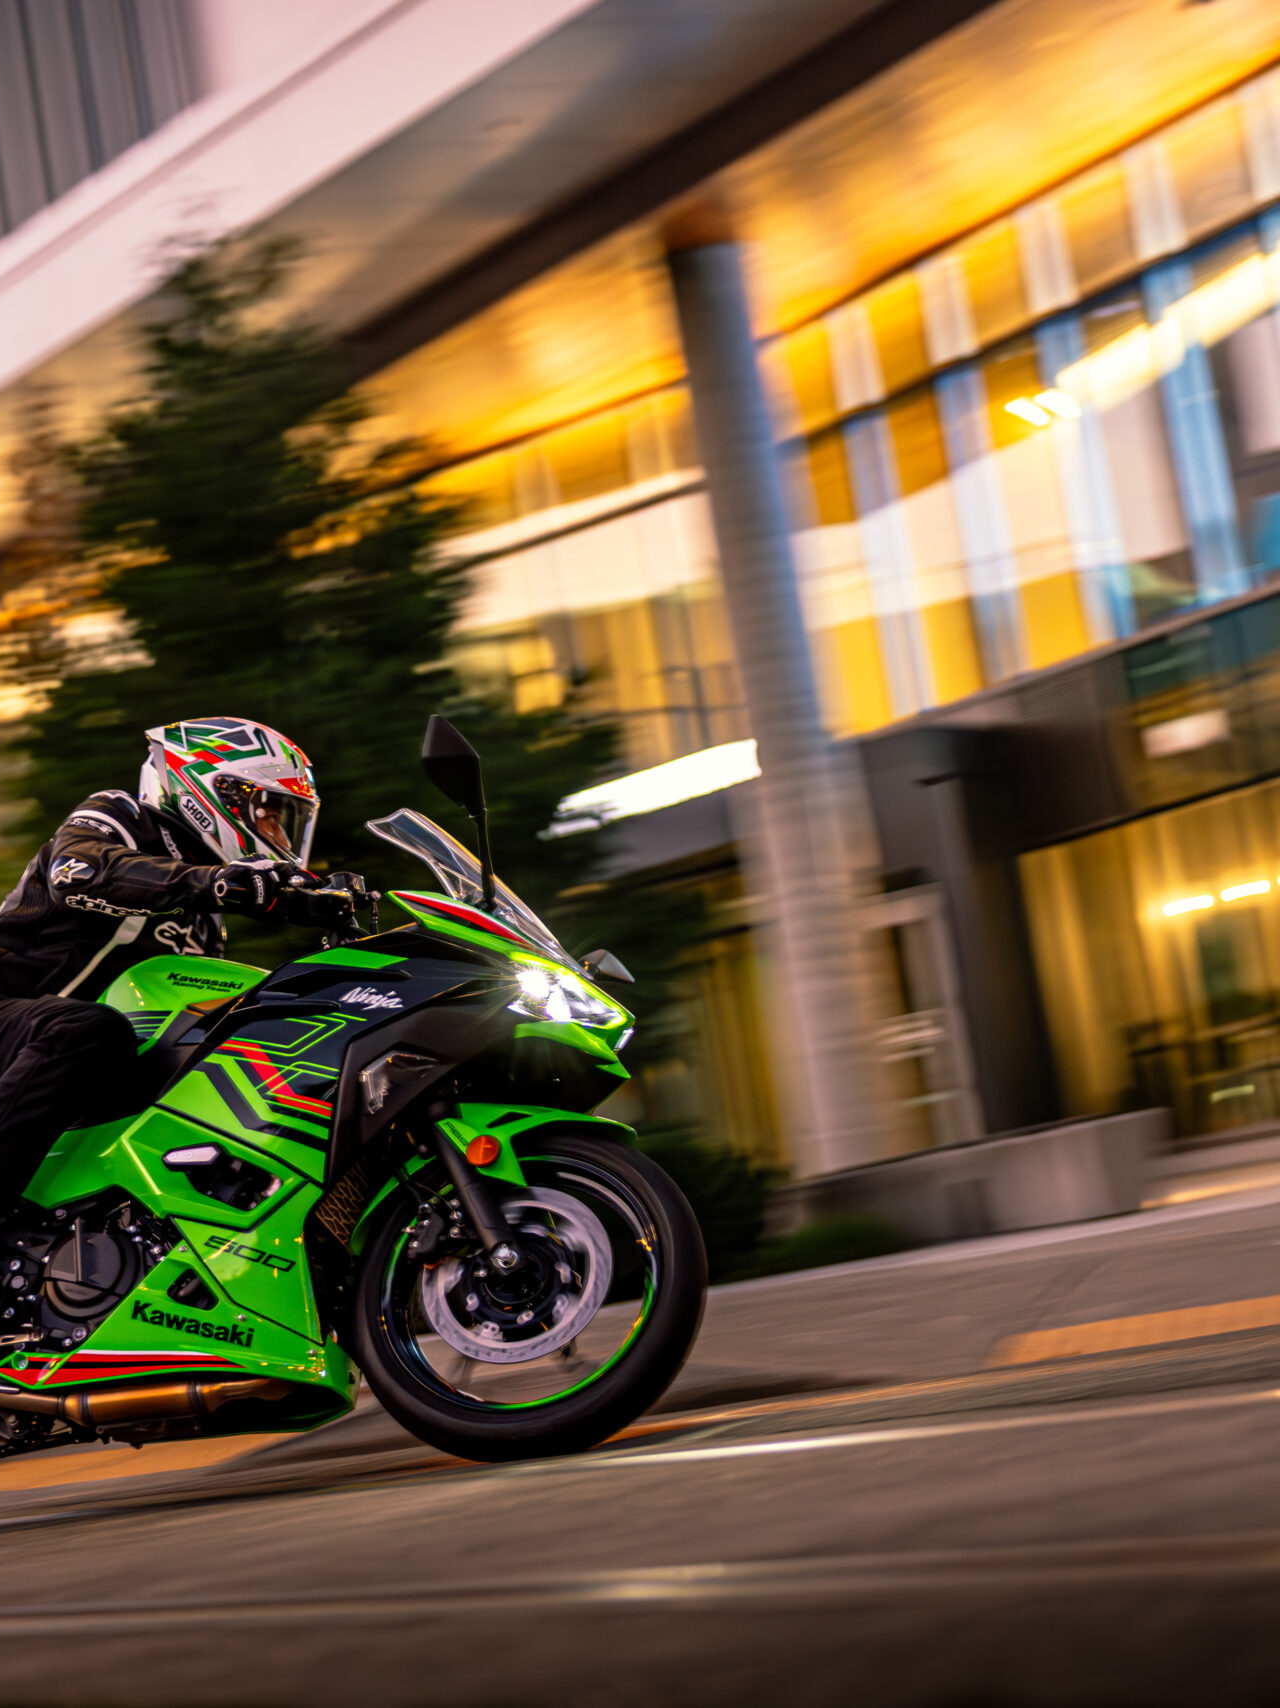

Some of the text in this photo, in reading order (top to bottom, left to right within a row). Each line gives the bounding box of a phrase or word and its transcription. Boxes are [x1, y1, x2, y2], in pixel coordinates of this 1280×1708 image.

[182, 798, 212, 830] SHOEI
[167, 972, 244, 990] Kawasaki
[172, 981, 231, 993] Racing Team
[339, 986, 404, 1010] Ninja
[204, 1235, 297, 1273] 500
[131, 1300, 255, 1348] Kawasaki
